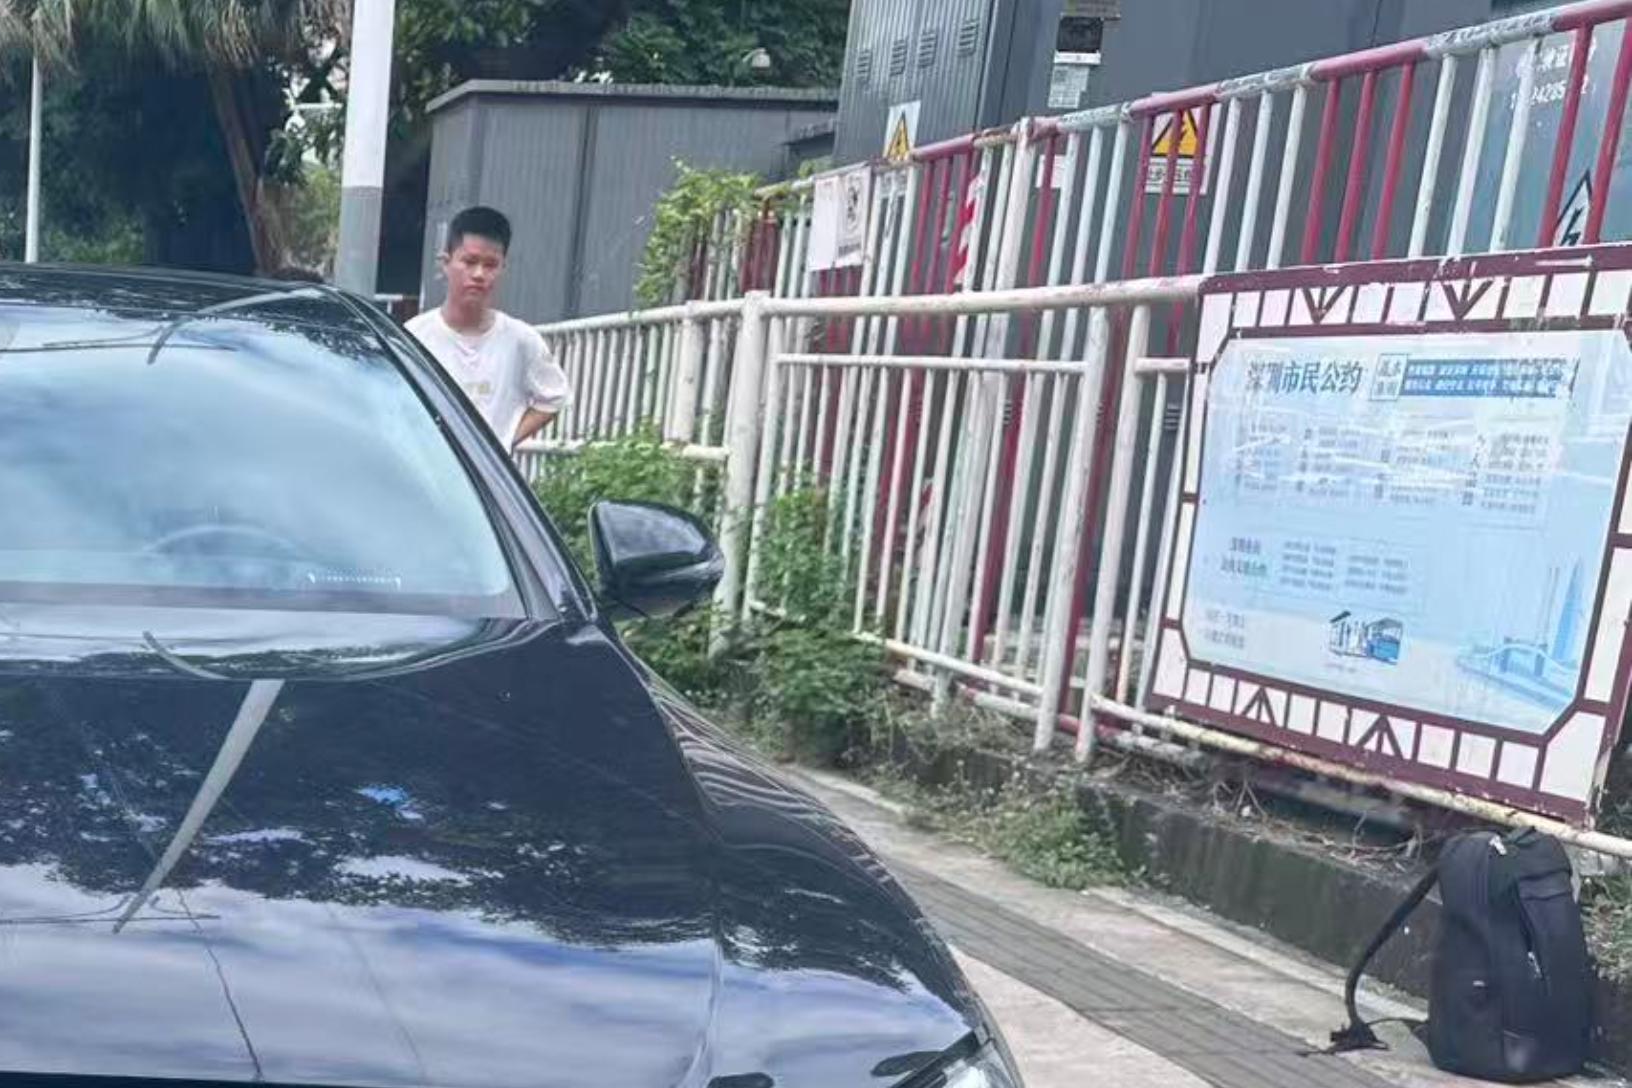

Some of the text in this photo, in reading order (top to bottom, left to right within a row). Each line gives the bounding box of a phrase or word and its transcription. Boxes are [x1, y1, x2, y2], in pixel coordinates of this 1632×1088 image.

[1246, 359, 1364, 394] 深圳市民公约
